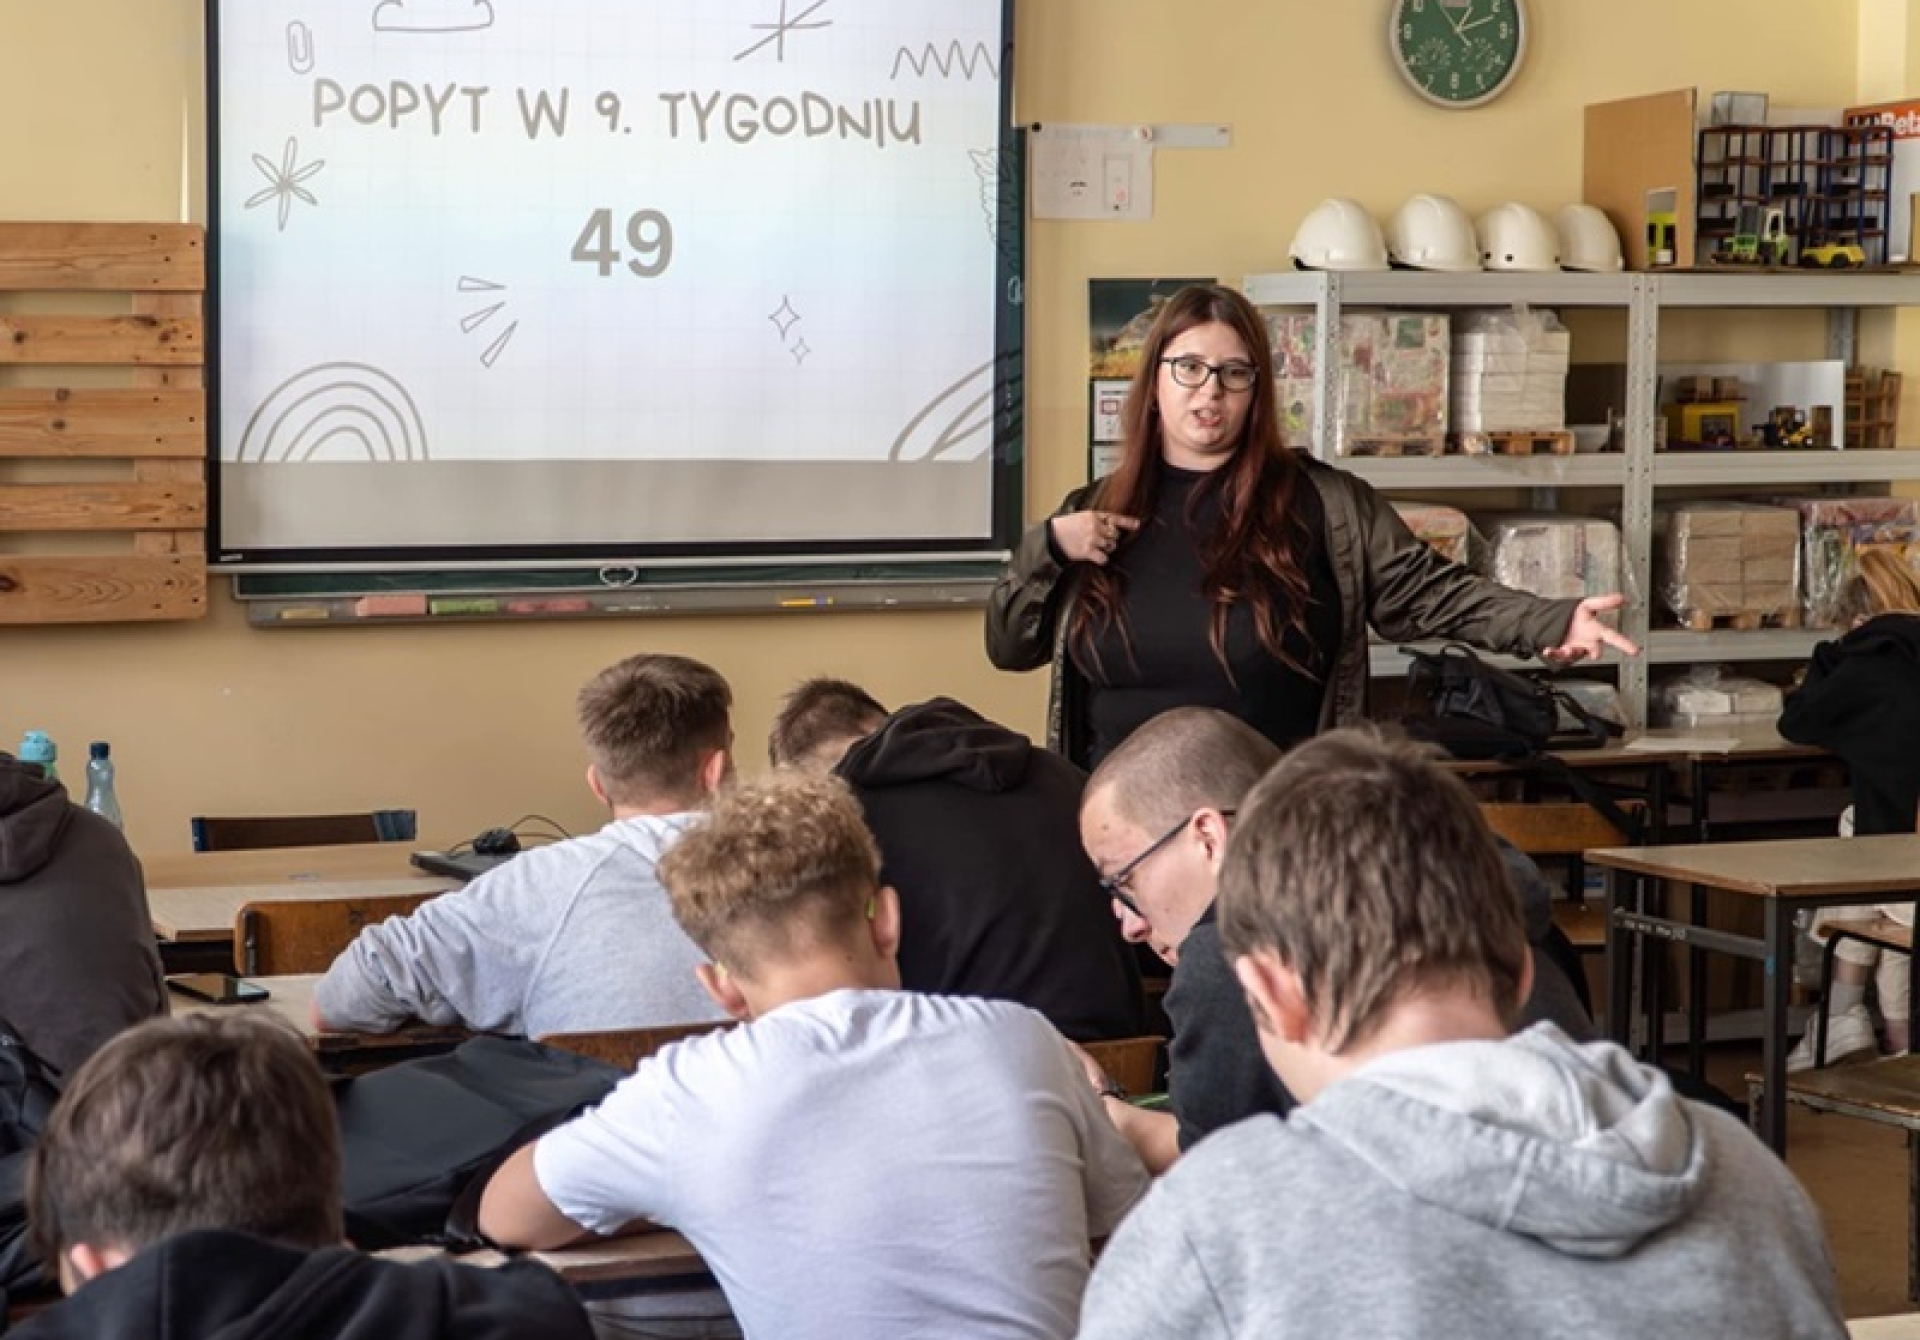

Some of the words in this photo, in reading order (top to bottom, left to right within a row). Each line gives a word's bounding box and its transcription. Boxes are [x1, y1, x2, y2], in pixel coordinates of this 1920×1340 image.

[313, 78, 489, 136] POPYT
[517, 87, 569, 140] W
[594, 90, 632, 135] 9.
[659, 90, 922, 149] TYGODNIU
[570, 208, 673, 279] 49
